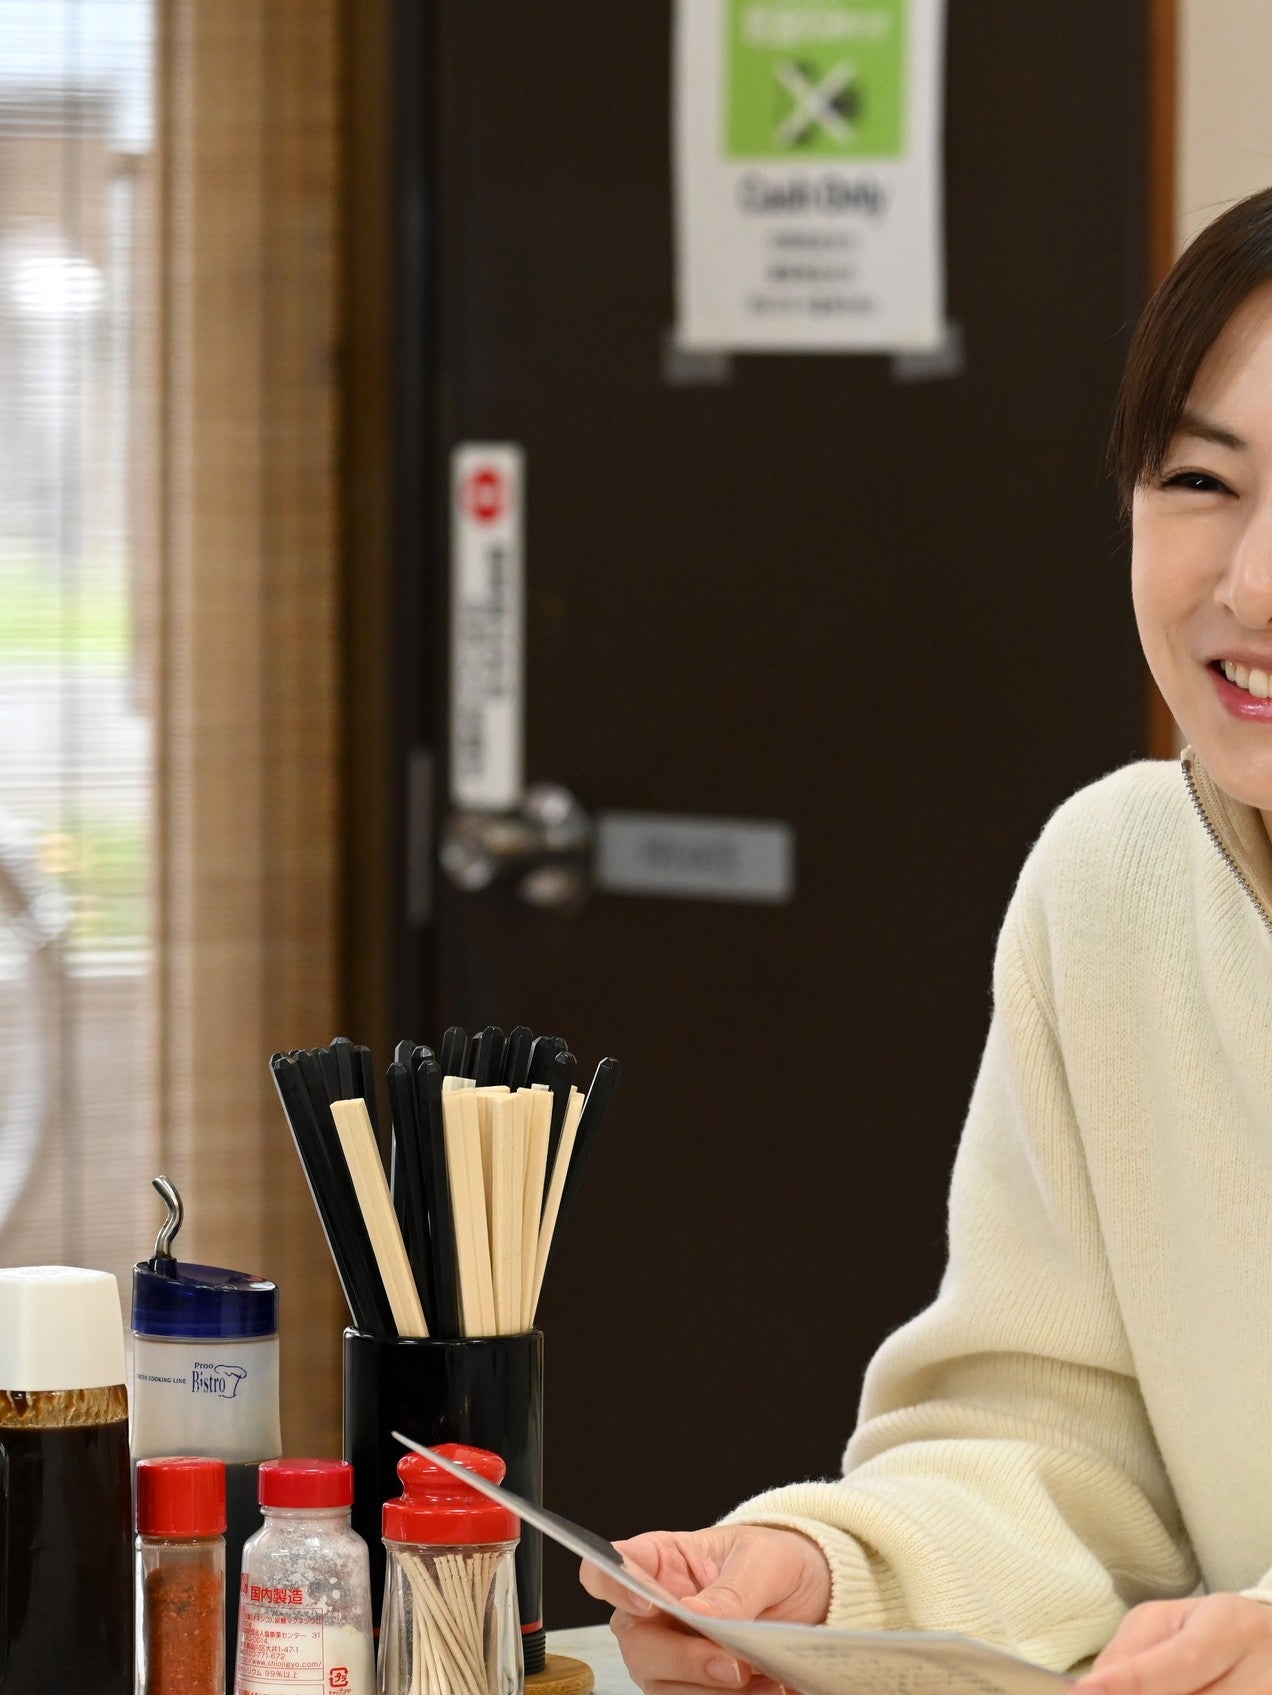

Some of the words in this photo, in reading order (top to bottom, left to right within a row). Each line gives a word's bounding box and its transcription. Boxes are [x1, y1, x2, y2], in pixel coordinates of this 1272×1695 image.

[148, 1375, 172, 1383] COOKING
[192, 1370, 226, 1393] Bistro
[251, 1586, 303, 1604] 国内製造
